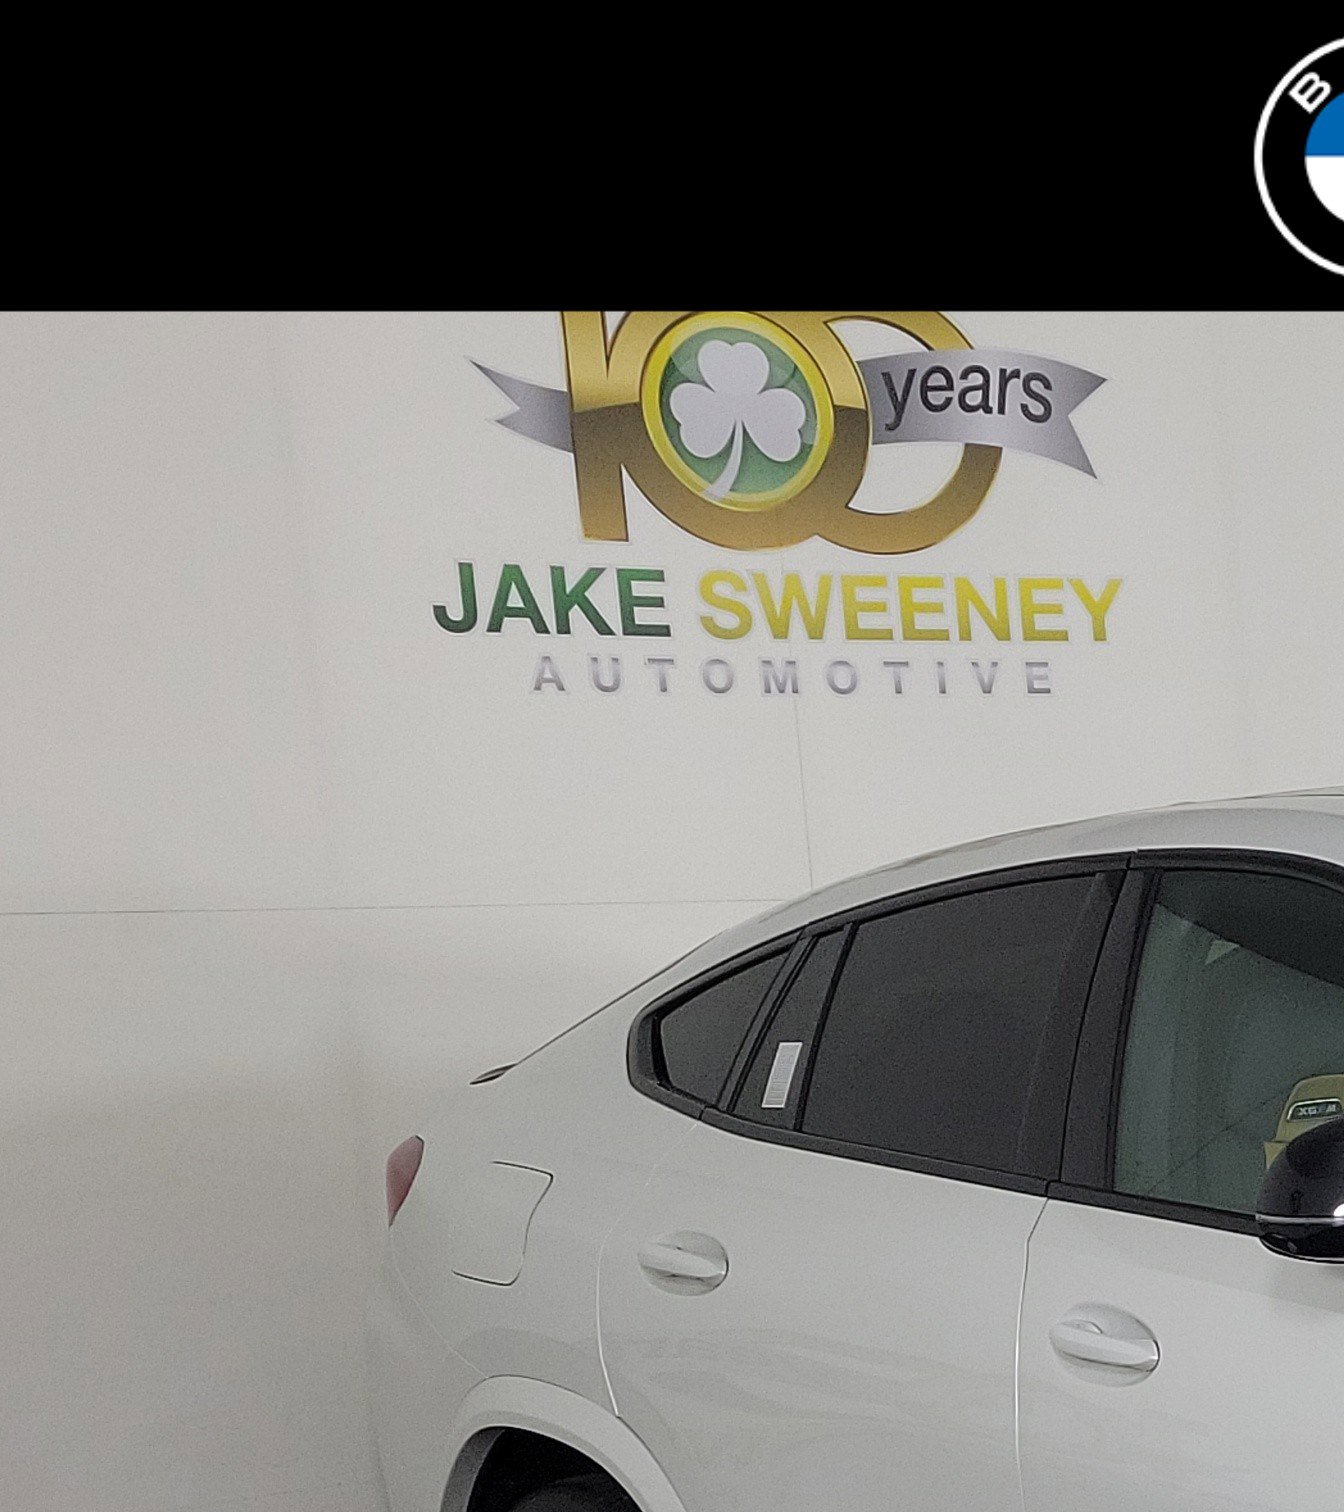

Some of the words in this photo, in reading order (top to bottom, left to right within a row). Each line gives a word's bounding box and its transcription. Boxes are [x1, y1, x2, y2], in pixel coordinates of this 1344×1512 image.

[880, 362, 1055, 434] years
[432, 561, 673, 638] JAKE
[698, 570, 1124, 642] SWEENEY
[532, 655, 1053, 695] AUTOMOTIVE
